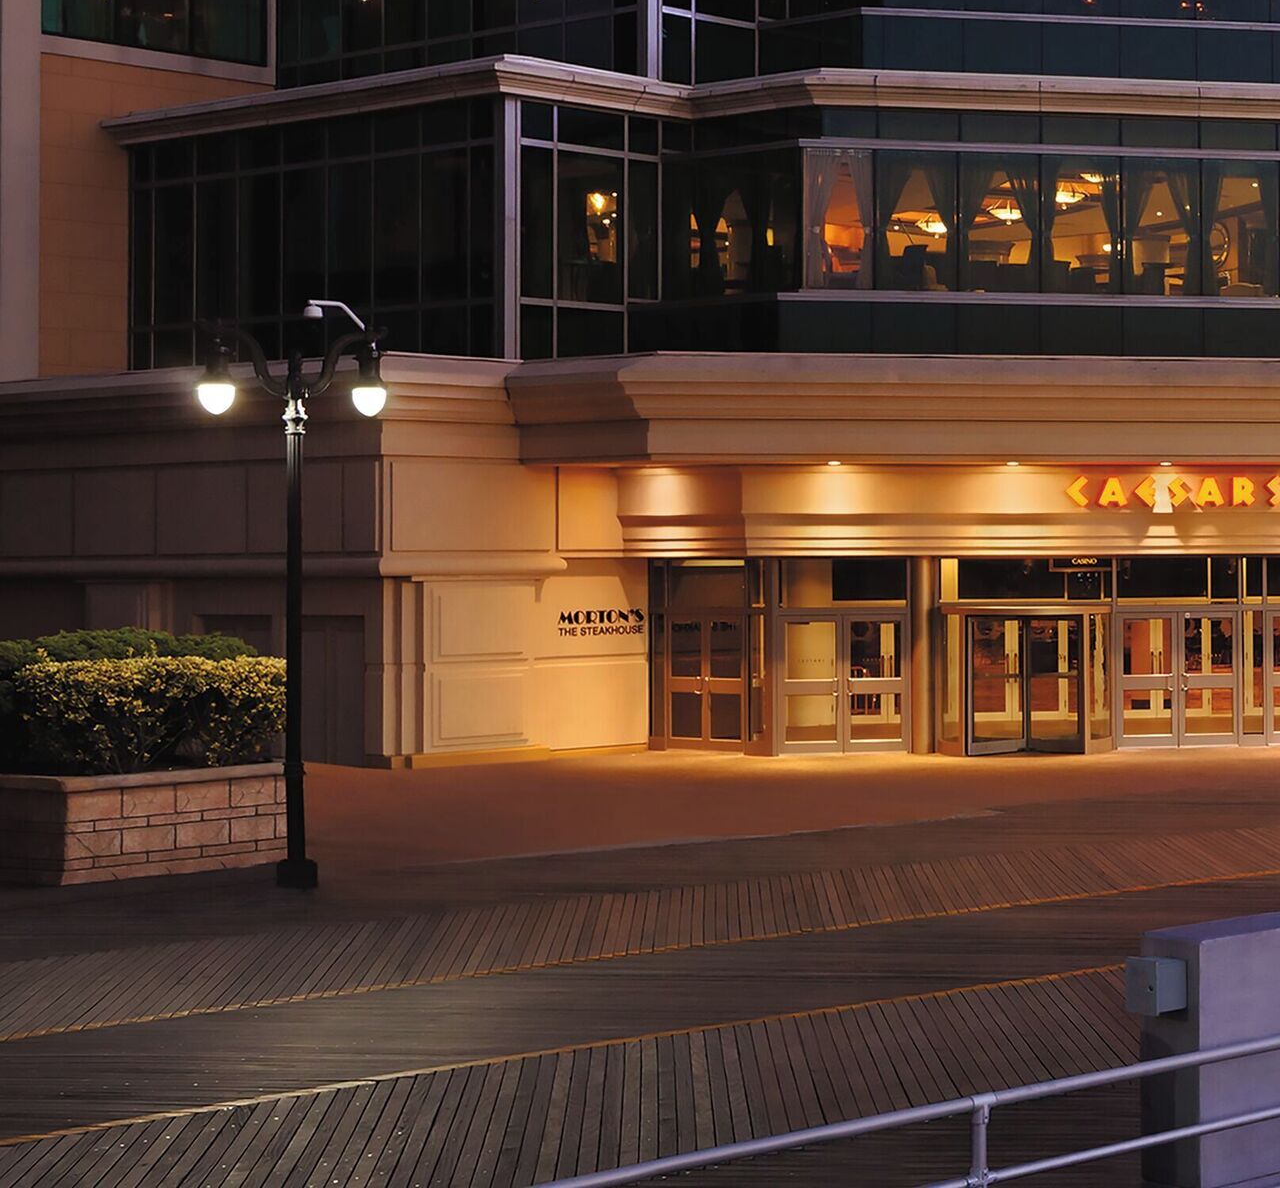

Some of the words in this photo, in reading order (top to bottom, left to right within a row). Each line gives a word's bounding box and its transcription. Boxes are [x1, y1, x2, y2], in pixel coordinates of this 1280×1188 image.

[1071, 557, 1098, 565] CASINO
[558, 608, 645, 625] MORTON'S
[558, 626, 578, 637] THE
[580, 624, 645, 637] STEAKHOUSE
